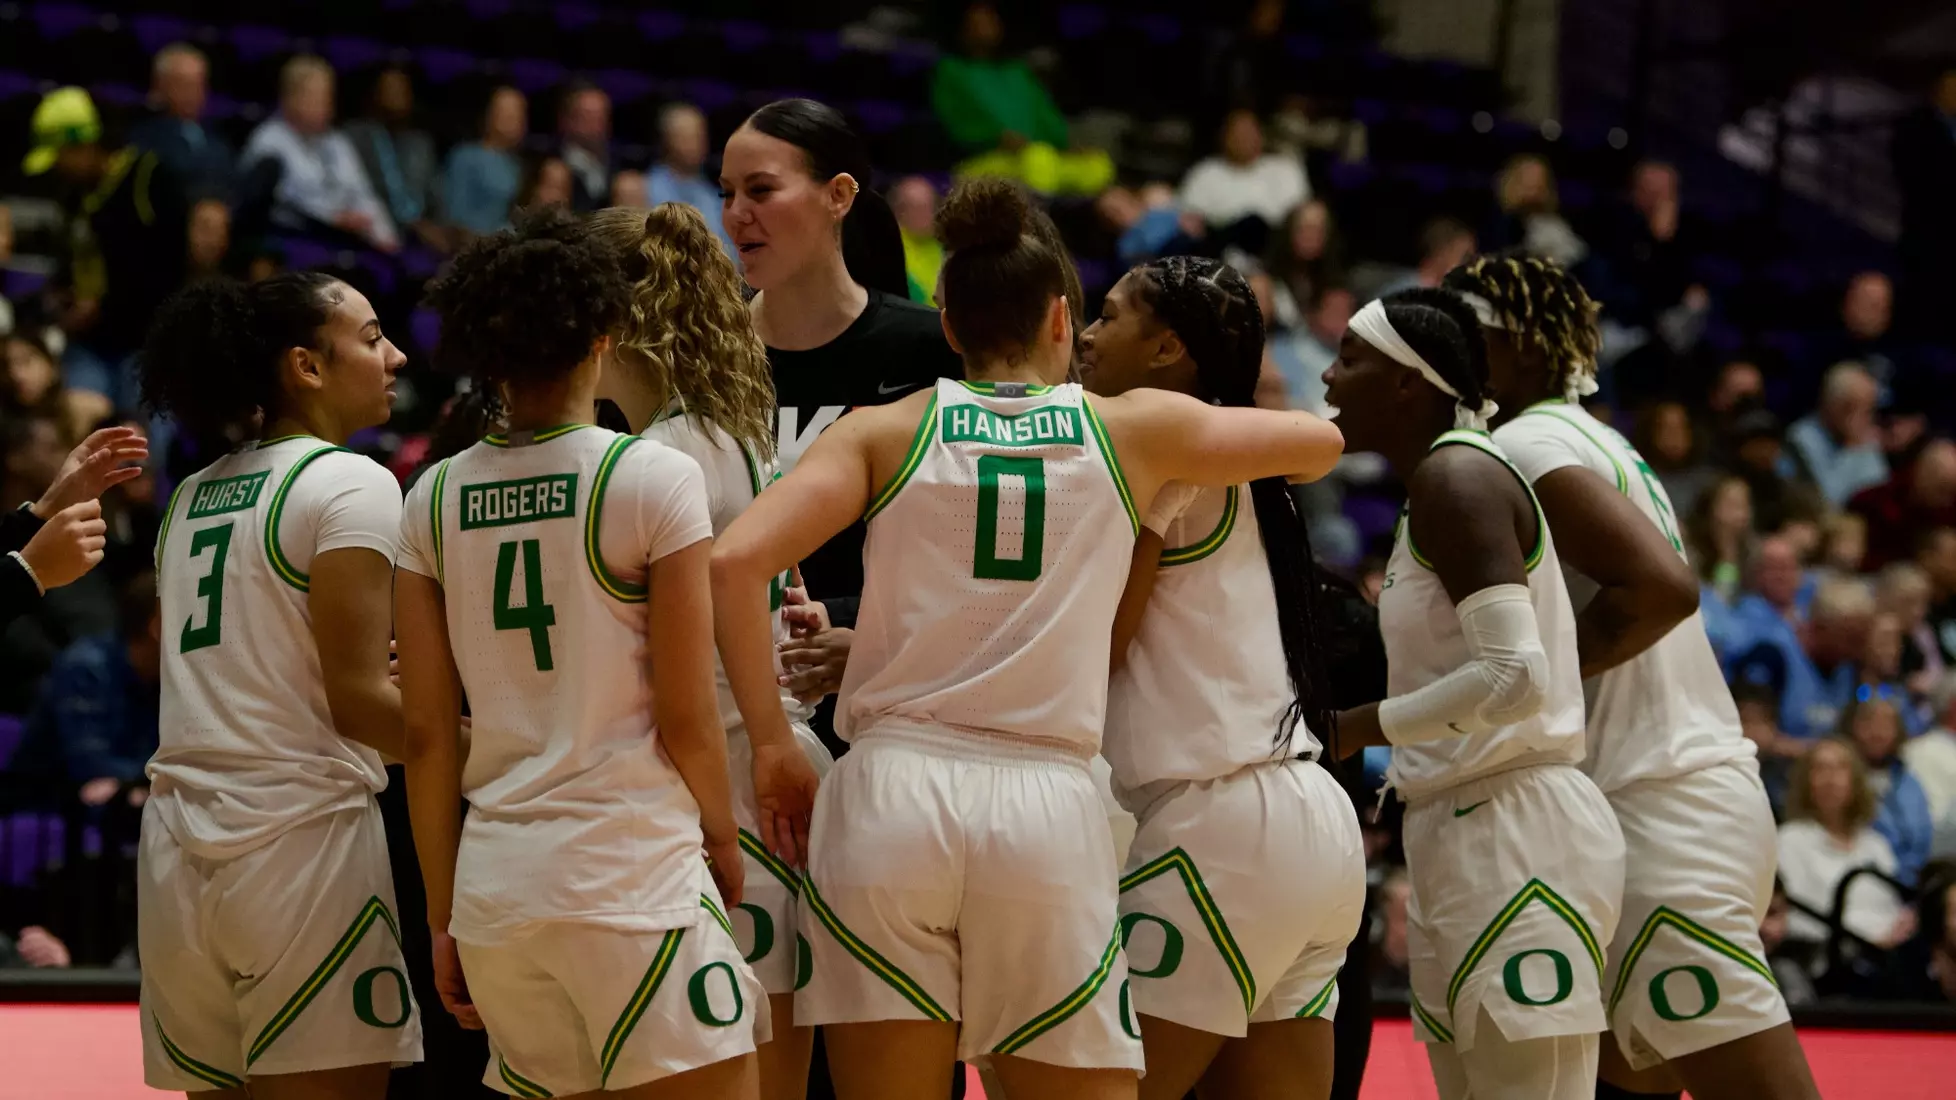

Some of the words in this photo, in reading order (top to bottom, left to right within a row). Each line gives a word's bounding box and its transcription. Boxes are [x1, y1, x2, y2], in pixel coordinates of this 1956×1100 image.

[952, 408, 1075, 443] HANSON
[193, 476, 264, 514] HURST
[467, 480, 568, 523] ROGERS
[180, 522, 234, 655] 3
[493, 539, 556, 671] 4
[352, 966, 411, 1028] O
[687, 961, 743, 1027] O
[1503, 949, 1573, 1006] O
[1650, 965, 1719, 1021] O
